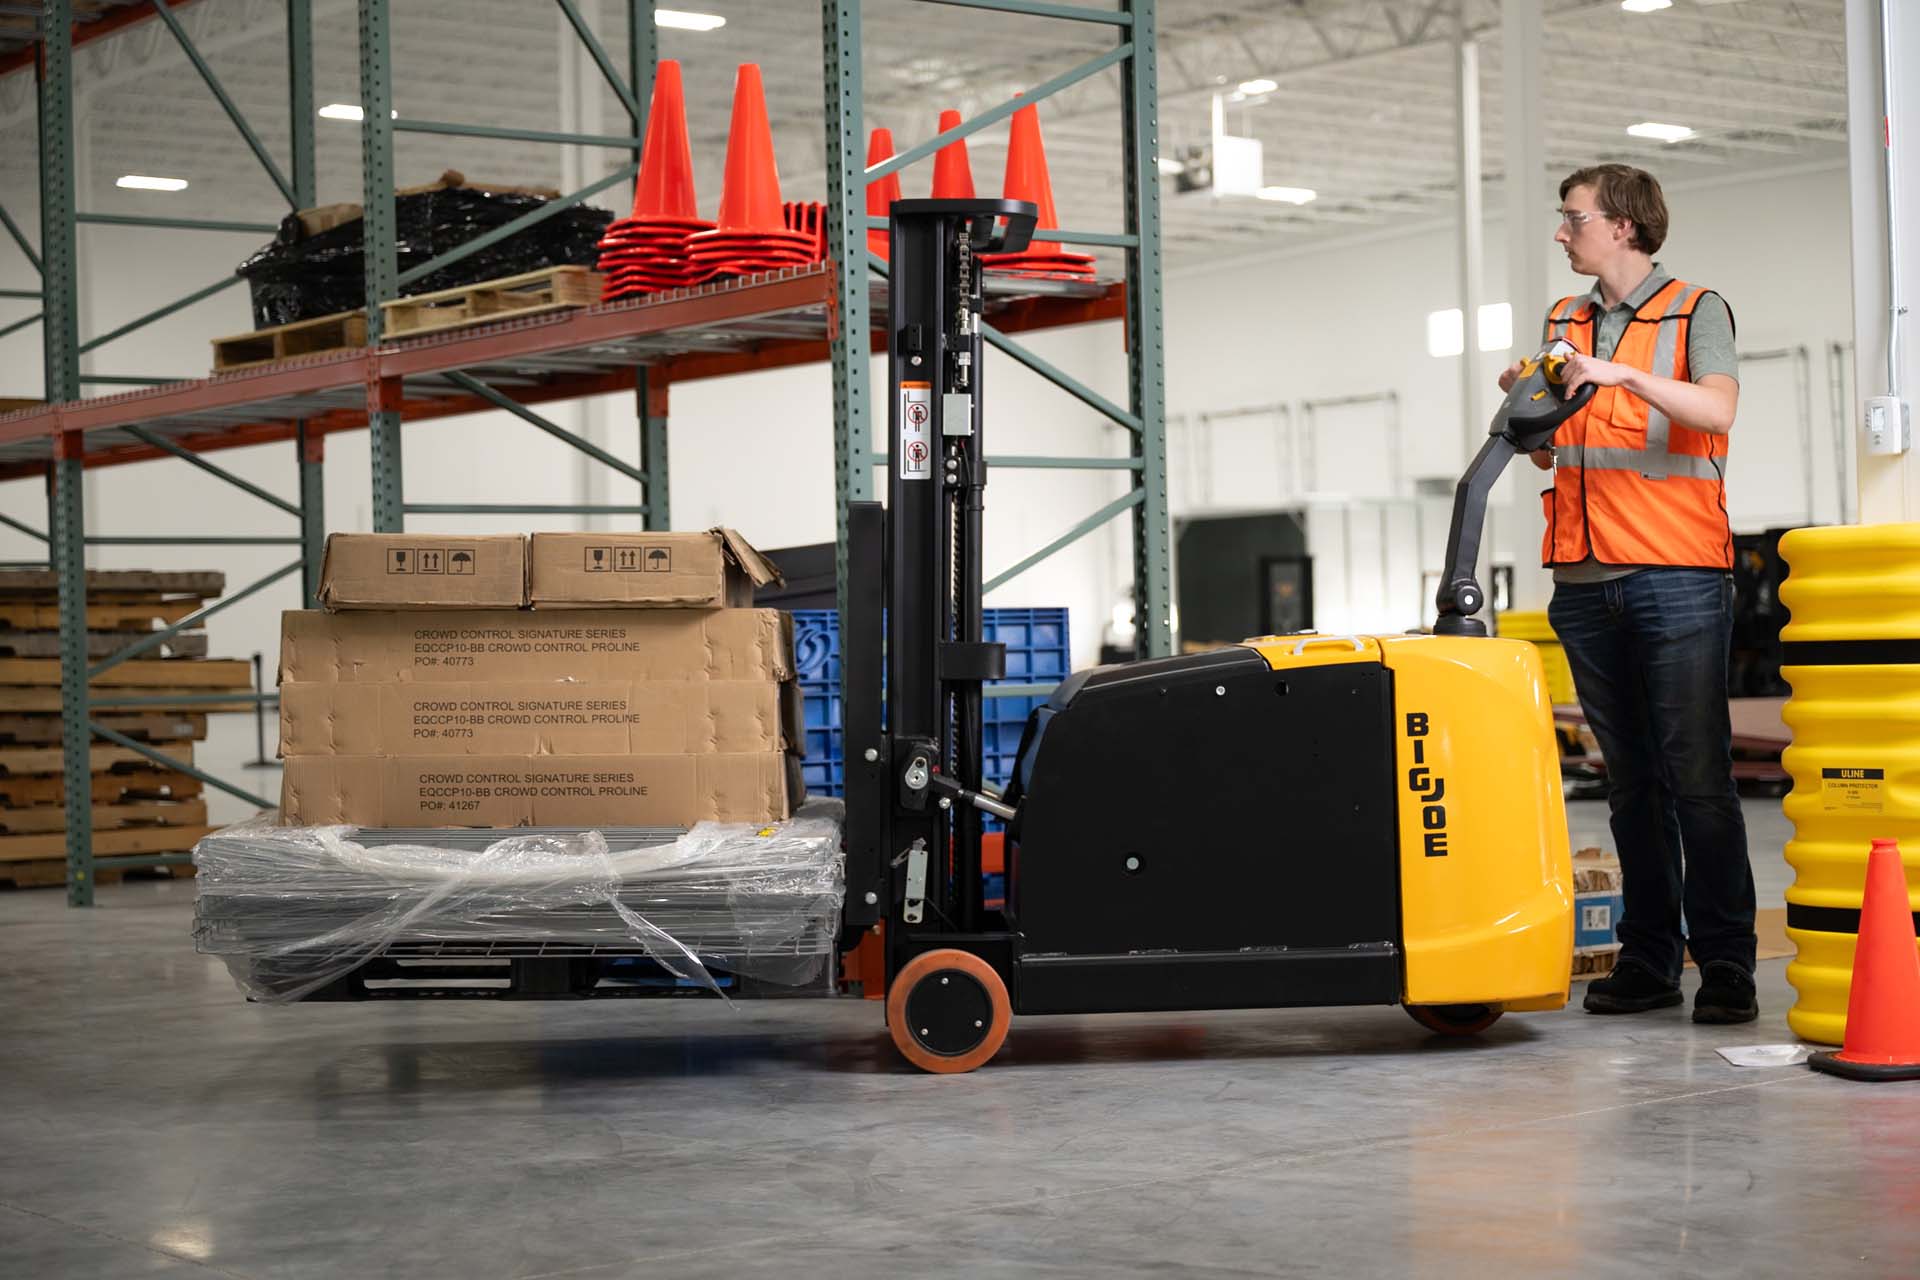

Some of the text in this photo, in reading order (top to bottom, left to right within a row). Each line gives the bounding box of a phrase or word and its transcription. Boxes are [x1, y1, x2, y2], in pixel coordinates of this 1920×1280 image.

[414, 628, 627, 640] CROWD CONTROL SIGNATURE SERIES
[414, 641, 640, 653] EQCCP10-BB CROWD CONTROL PROLINE
[414, 656, 474, 667] PO#: 40773
[413, 700, 627, 712] CROWD CONTROL SIGNATURE SERIES
[413, 713, 640, 725] EQCCP10-BB CROWD CONTROL PROLINE
[413, 728, 474, 739] PO#: 40773
[419, 772, 634, 784] CROWD CONTROL SIGNATURE SERIES
[1841, 769, 1865, 778] ULINE
[1406, 712, 1448, 857] BIG JOE
[419, 786, 648, 798] EQCCP10-BB CROWD CONTROL PROLINE
[420, 800, 480, 811] PO#: 41267
